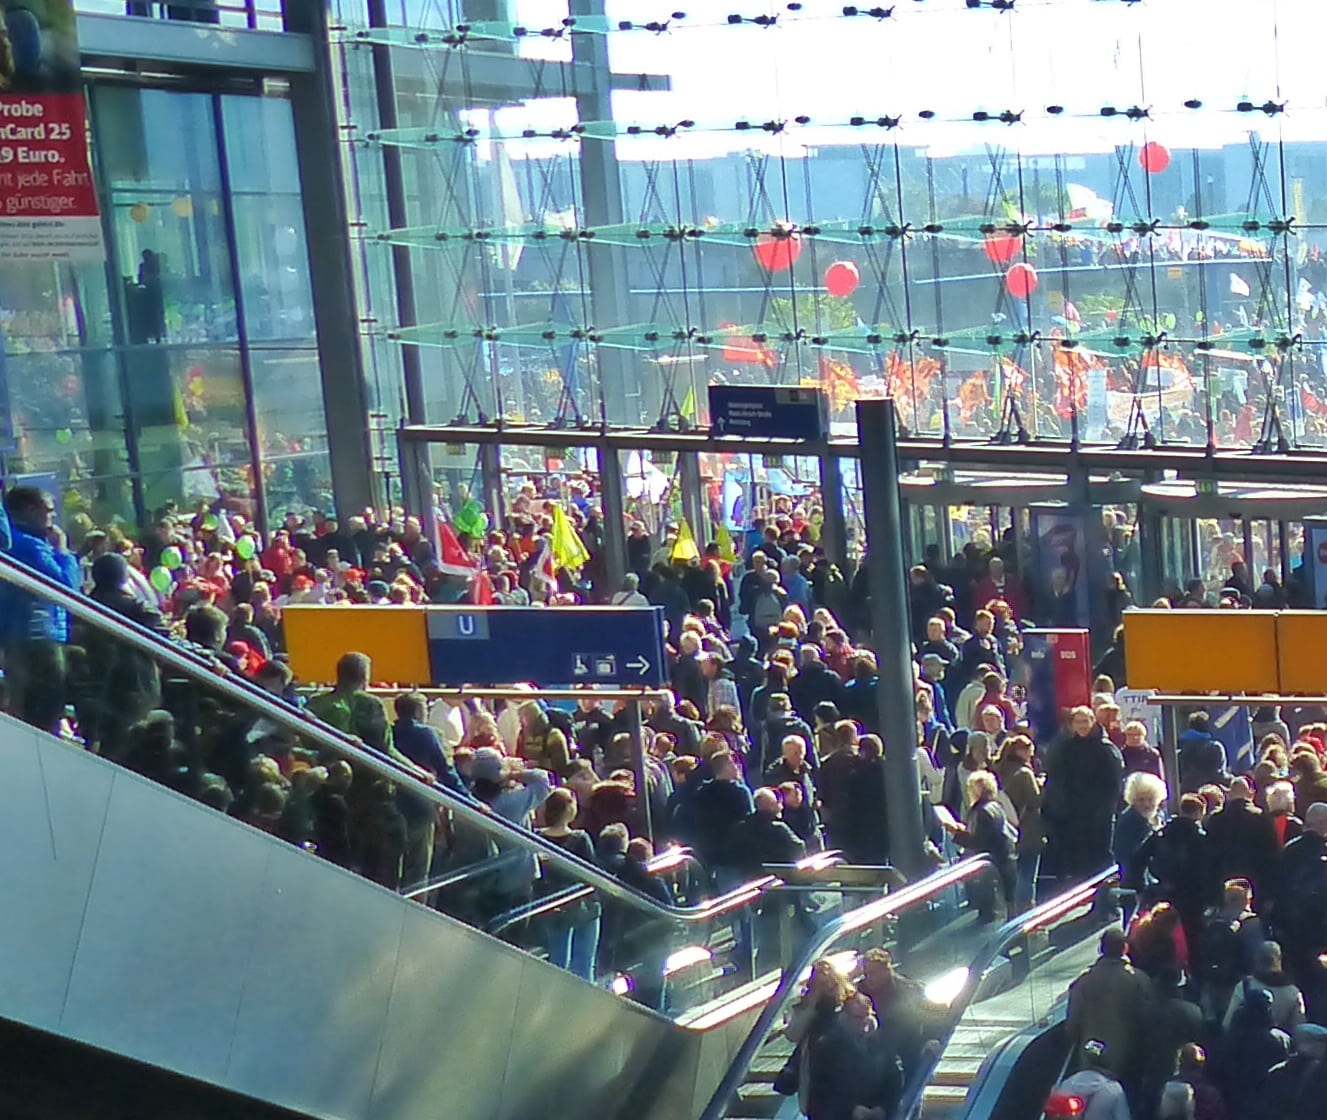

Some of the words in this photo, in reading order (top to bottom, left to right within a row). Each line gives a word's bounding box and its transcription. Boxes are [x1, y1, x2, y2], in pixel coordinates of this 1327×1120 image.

[48, 123, 71, 140] 25
[0, 146, 14, 163] 9
[17, 146, 66, 164] Euro.
[17, 169, 49, 190] jede
[458, 615, 474, 635] U
